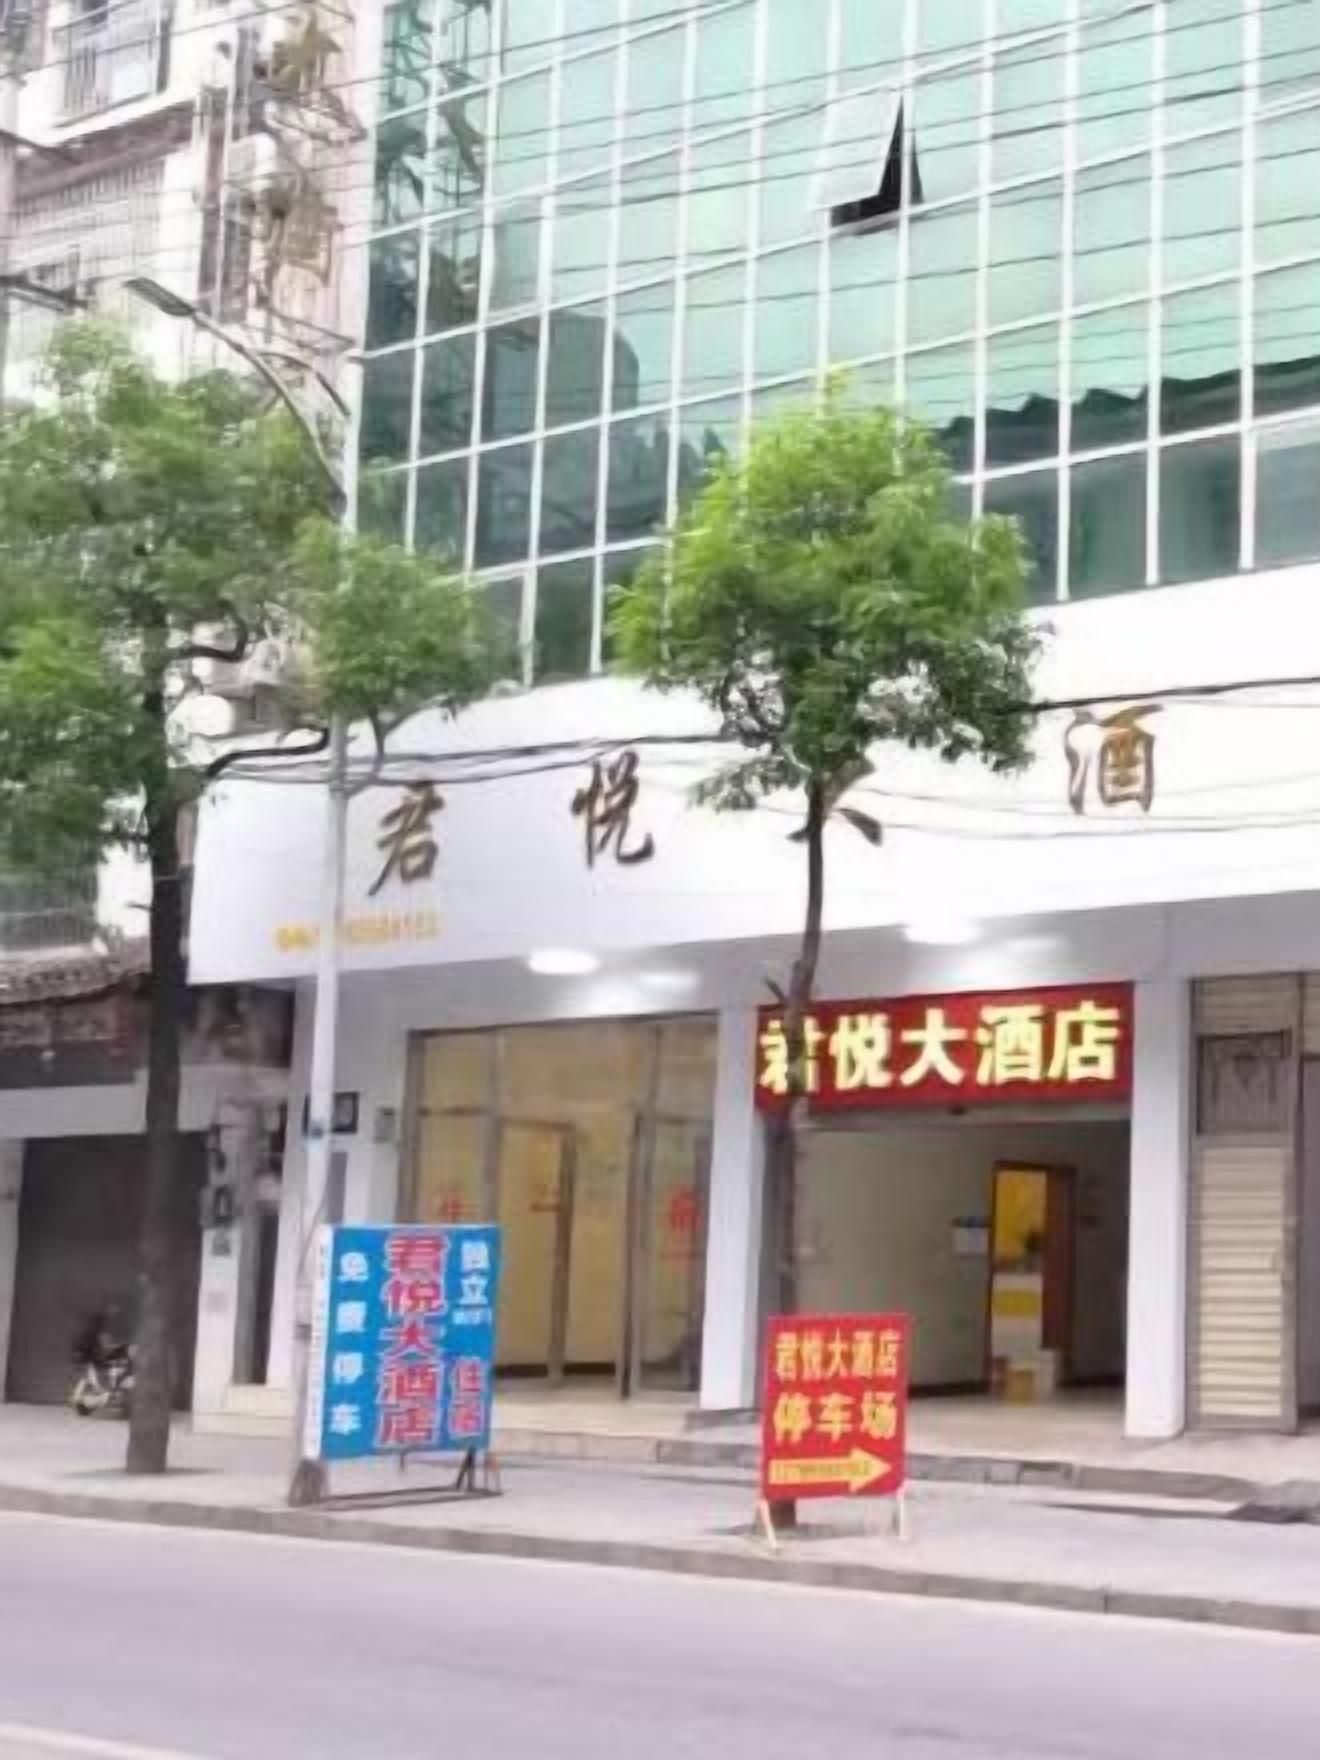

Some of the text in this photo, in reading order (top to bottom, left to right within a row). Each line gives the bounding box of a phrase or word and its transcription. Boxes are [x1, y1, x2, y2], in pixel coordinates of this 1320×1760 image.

[760, 1000, 1120, 1094] 君悦大酒店
[328, 1251, 369, 1436] 免费停车
[375, 1233, 450, 1447] 君悦大酒店
[775, 1328, 901, 1382] 君悦大酒店
[772, 1391, 897, 1445] 停车场
